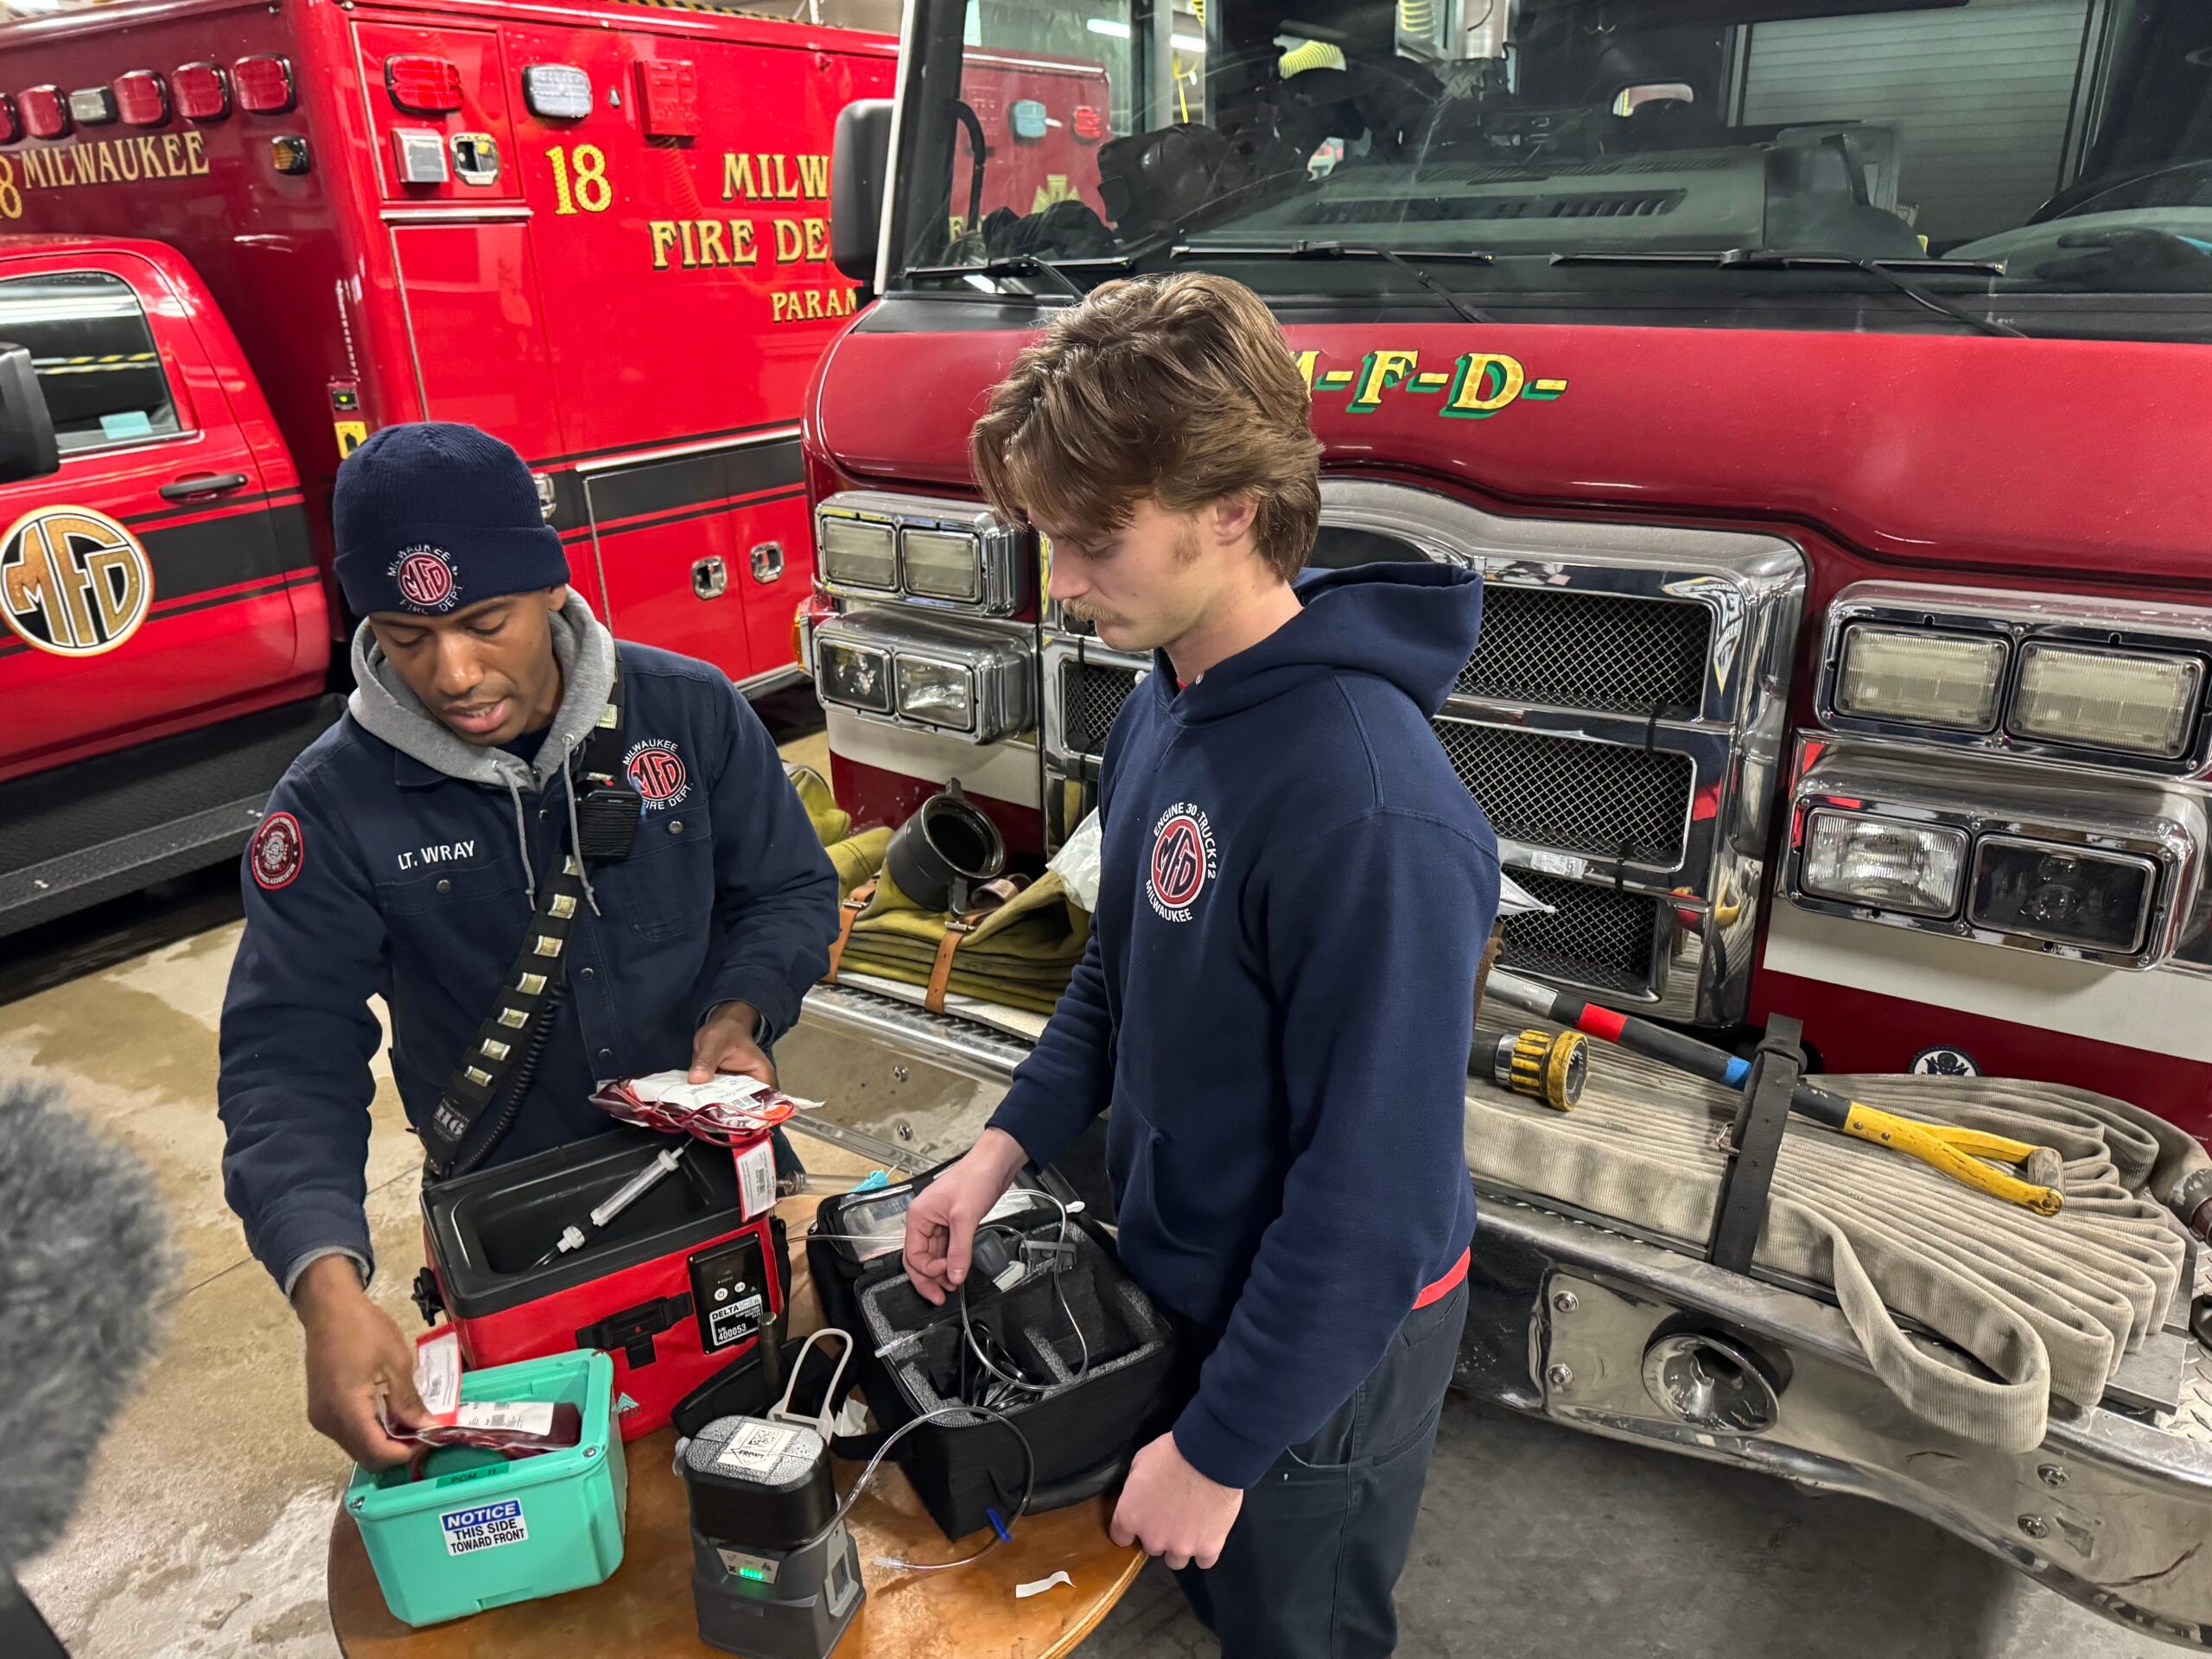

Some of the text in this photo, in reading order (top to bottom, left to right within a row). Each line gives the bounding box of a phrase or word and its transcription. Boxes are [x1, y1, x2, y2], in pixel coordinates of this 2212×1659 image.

[22, 130, 209, 188] MILWAUKEE
[545, 144, 612, 215] 18
[722, 153, 830, 201] MILW
[0, 155, 22, 219] 8
[649, 219, 832, 270] FIRE DE
[2, 514, 140, 647] MFD
[402, 557, 447, 601] MFD
[622, 739, 678, 766] MILWAUKEE
[631, 750, 682, 798] MFD
[397, 840, 474, 870] LT. WRAY
[1154, 802, 1217, 880] ENGINE 30 TRUCK 12
[1156, 826, 1197, 898] MFD
[1145, 880, 1193, 923] MILWAUKEE
[718, 1323, 747, 1341] 400053
[448, 1503, 517, 1529] NOTICE
[454, 1518, 518, 1541] THIS SIDE
[450, 1529, 524, 1554] TOWARD FRONT
